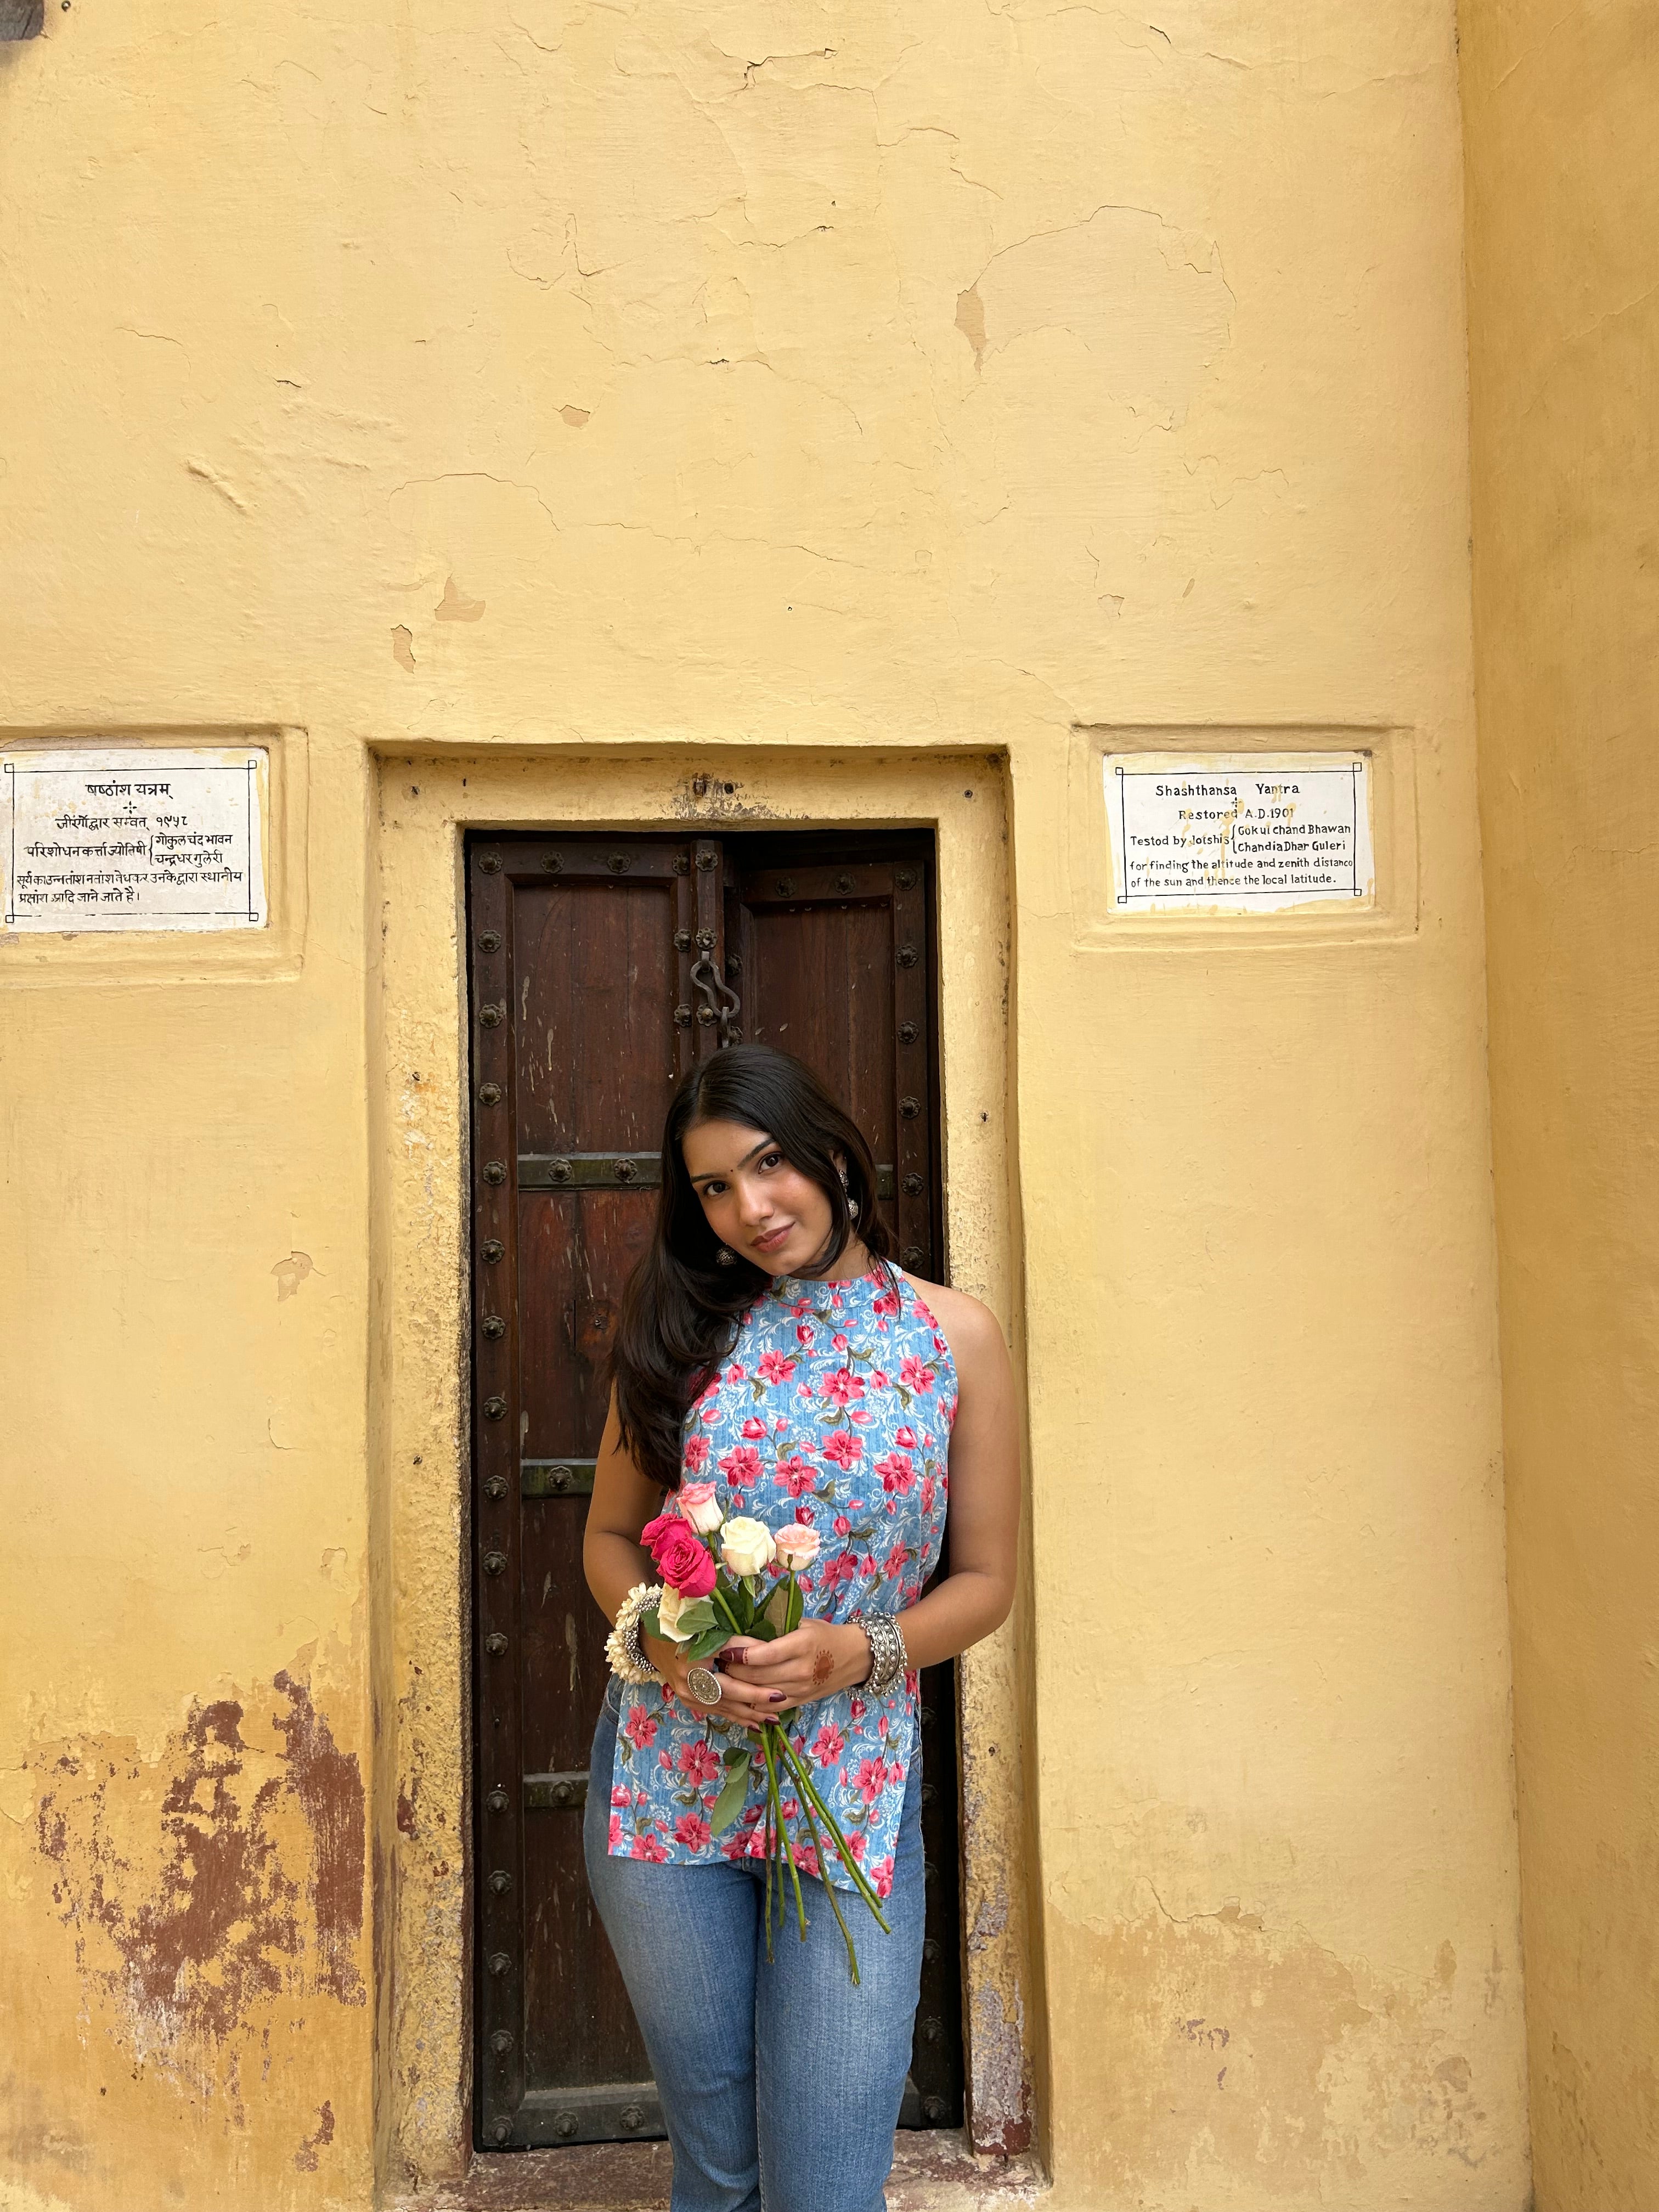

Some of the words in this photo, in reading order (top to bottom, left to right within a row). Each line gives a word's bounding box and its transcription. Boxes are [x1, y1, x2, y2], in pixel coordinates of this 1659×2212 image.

[1155, 785, 1237, 796] Shashthansa
[1255, 783, 1301, 794] Yantra
[1178, 809, 1238, 820] Restored
[1307, 824, 1351, 834] Bhawan
[1172, 836, 1187, 848] by
[1312, 840, 1345, 851] Guleri
[194, 849, 223, 868] गुलेरी
[1130, 861, 1147, 871] for
[1149, 860, 1189, 873] finding
[1191, 859, 1209, 870] the
[1211, 859, 1253, 869] altitude
[1257, 857, 1276, 868] and
[1278, 857, 1310, 868] zenith
[1131, 877, 1141, 888] of
[1144, 878, 1160, 887] the
[1186, 876, 1204, 887] and
[1243, 874, 1260, 885] the
[1261, 874, 1287, 885] local
[100, 887, 123, 902] जाते
